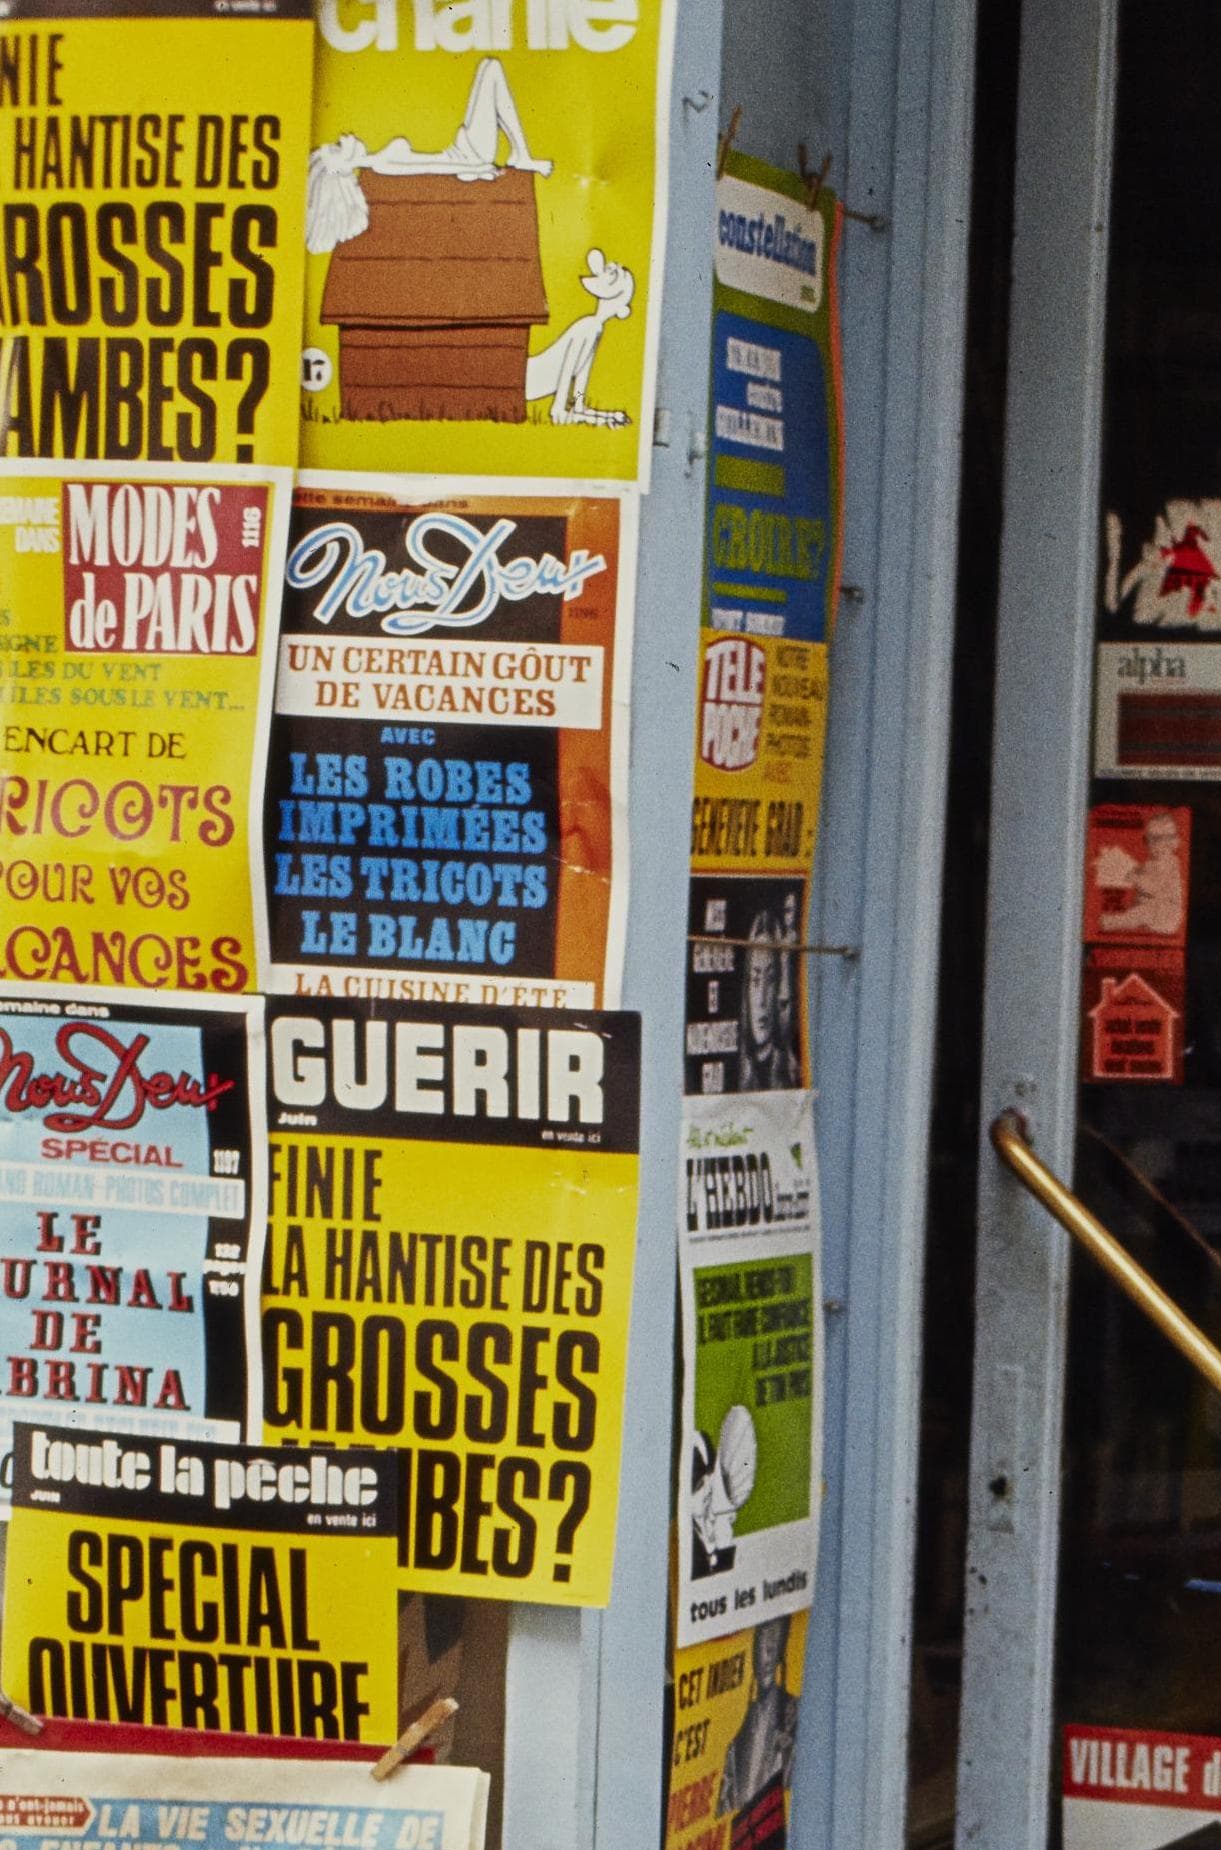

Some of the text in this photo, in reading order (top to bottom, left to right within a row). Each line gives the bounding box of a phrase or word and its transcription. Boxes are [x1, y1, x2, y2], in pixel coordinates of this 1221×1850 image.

[15, 114, 281, 191] HANTISE DES
[67, 484, 221, 568] MODES
[287, 512, 607, 634] Nous Deux
[70, 572, 257, 653] de PARIS
[64, 662, 161, 682] DU VENT
[288, 644, 592, 684] UN CERTAIN GÔUT
[1117, 647, 1187, 686] alpha
[71, 688, 126, 706] SOUS
[131, 691, 155, 709] LE
[315, 681, 557, 717] DE VACANCES
[4, 727, 187, 758] ENCART DE
[380, 726, 436, 746] AVEC
[290, 752, 533, 806] LES ROBES
[279, 800, 548, 855] IMPRIMÉES
[0, 860, 190, 911] OUR VOS
[274, 853, 549, 909] LES TRICOTS
[0, 925, 248, 993] CANCES
[300, 910, 517, 965] LE BLANC
[295, 974, 469, 1004] LA CUISINE
[44, 1021, 236, 1133] Deux
[271, 1016, 604, 1125] GUERIR
[268, 1143, 384, 1222] FINIE
[686, 1152, 774, 1231] L'HEBDO
[36, 1211, 102, 1256] LE
[1, 1259, 194, 1313] URNAL
[262, 1223, 605, 1317] LA HANTISE DES
[30, 1310, 102, 1354] DE
[6, 1356, 191, 1411] BRINA
[262, 1307, 600, 1453] GROSSES
[31, 1431, 379, 1510] toute la pêche
[307, 1512, 377, 1528] en vente ici
[67, 1530, 320, 1652] SPECIAL
[690, 1569, 808, 1623] tous les lundis
[28, 1636, 371, 1742] OUVERTURE
[1069, 1736, 1190, 1793] VILLAGE
[98, 1804, 142, 1840] LA
[157, 1806, 209, 1842] VIE
[225, 1808, 386, 1849] SEXUELLE
